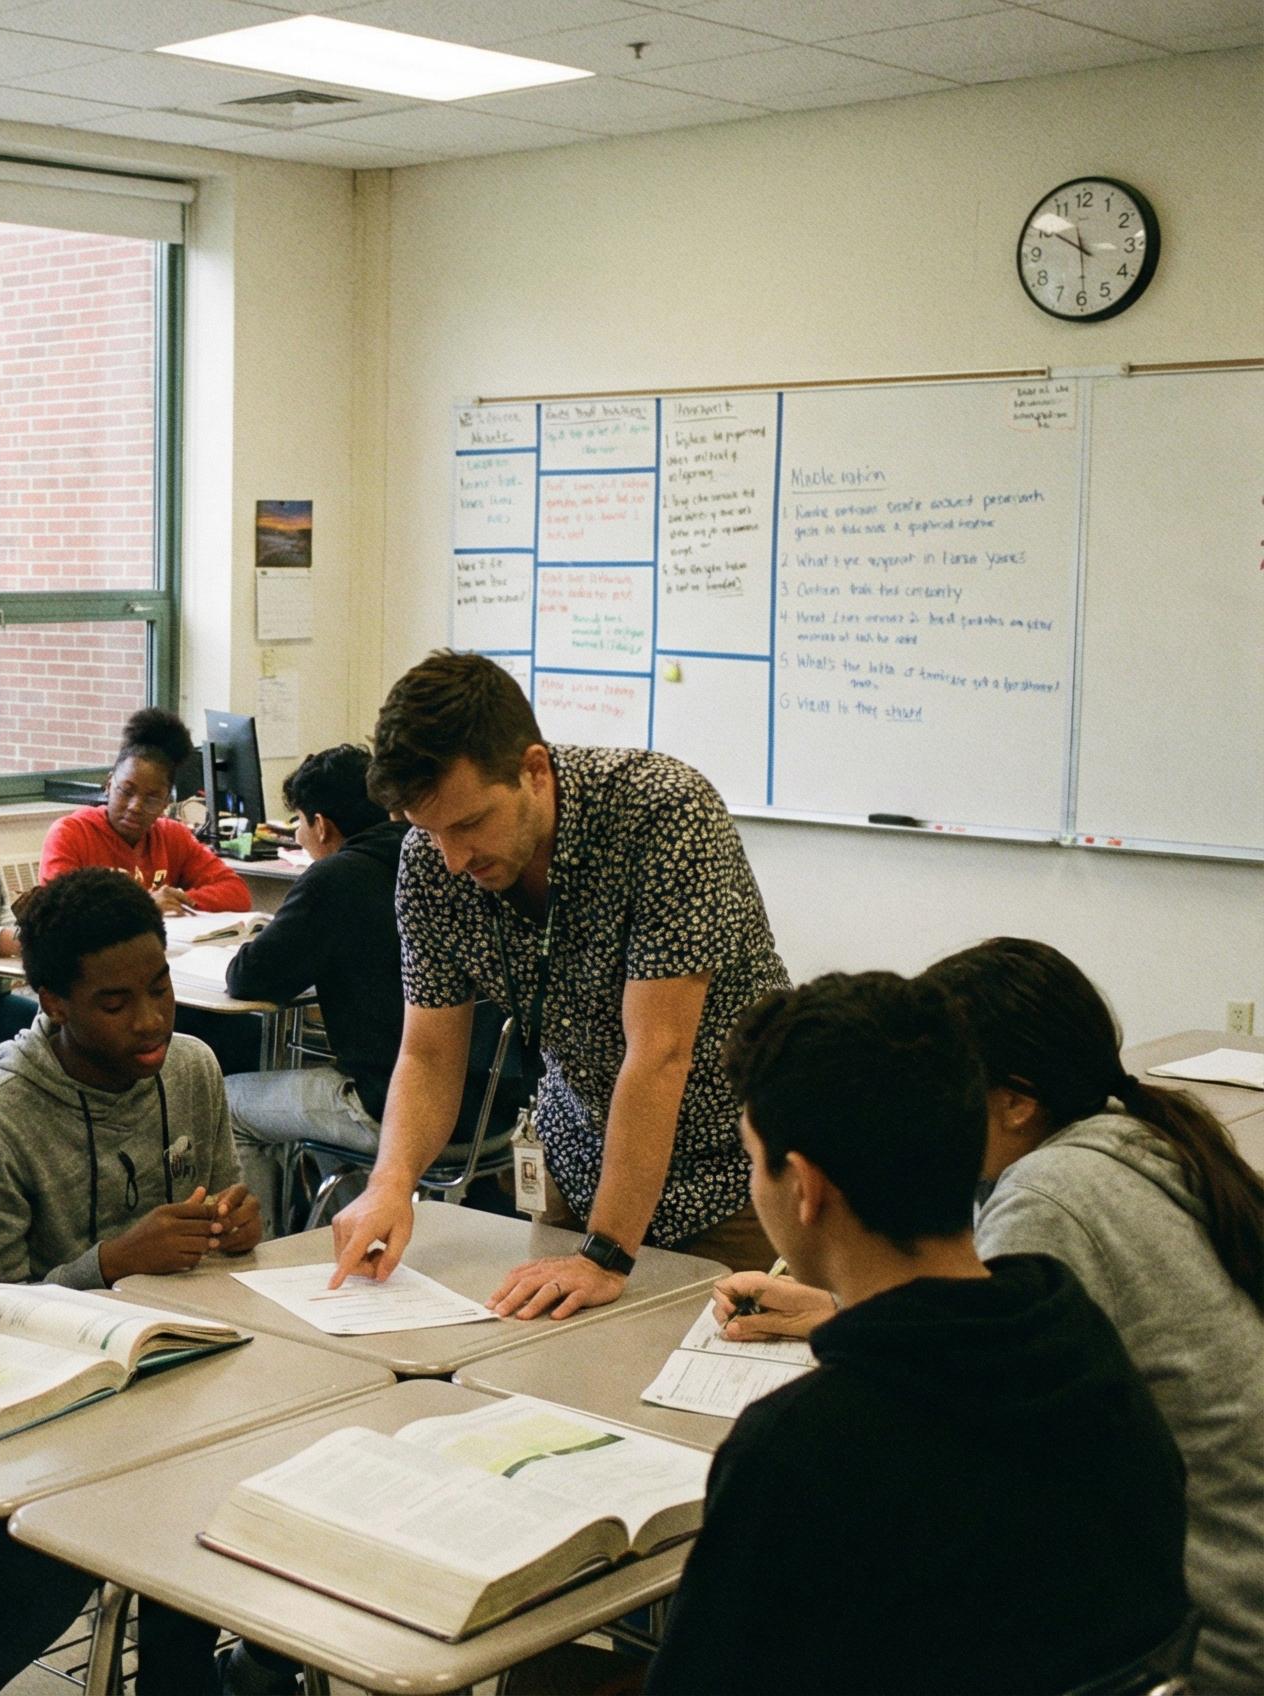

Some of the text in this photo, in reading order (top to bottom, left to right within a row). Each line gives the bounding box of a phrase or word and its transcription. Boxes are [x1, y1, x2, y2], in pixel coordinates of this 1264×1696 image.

[1075, 191, 1093, 208] 12
[1105, 198, 1111, 213] 1
[1056, 202, 1069, 217] 11
[1118, 212, 1130, 229] 2
[1124, 237, 1136, 254] 3
[1031, 246, 1042, 263] 9
[1037, 270, 1049, 286] 8
[1116, 262, 1129, 279] 4
[1055, 285, 1065, 302] 7
[1099, 281, 1111, 298] 5
[1076, 290, 1087, 307] 6
